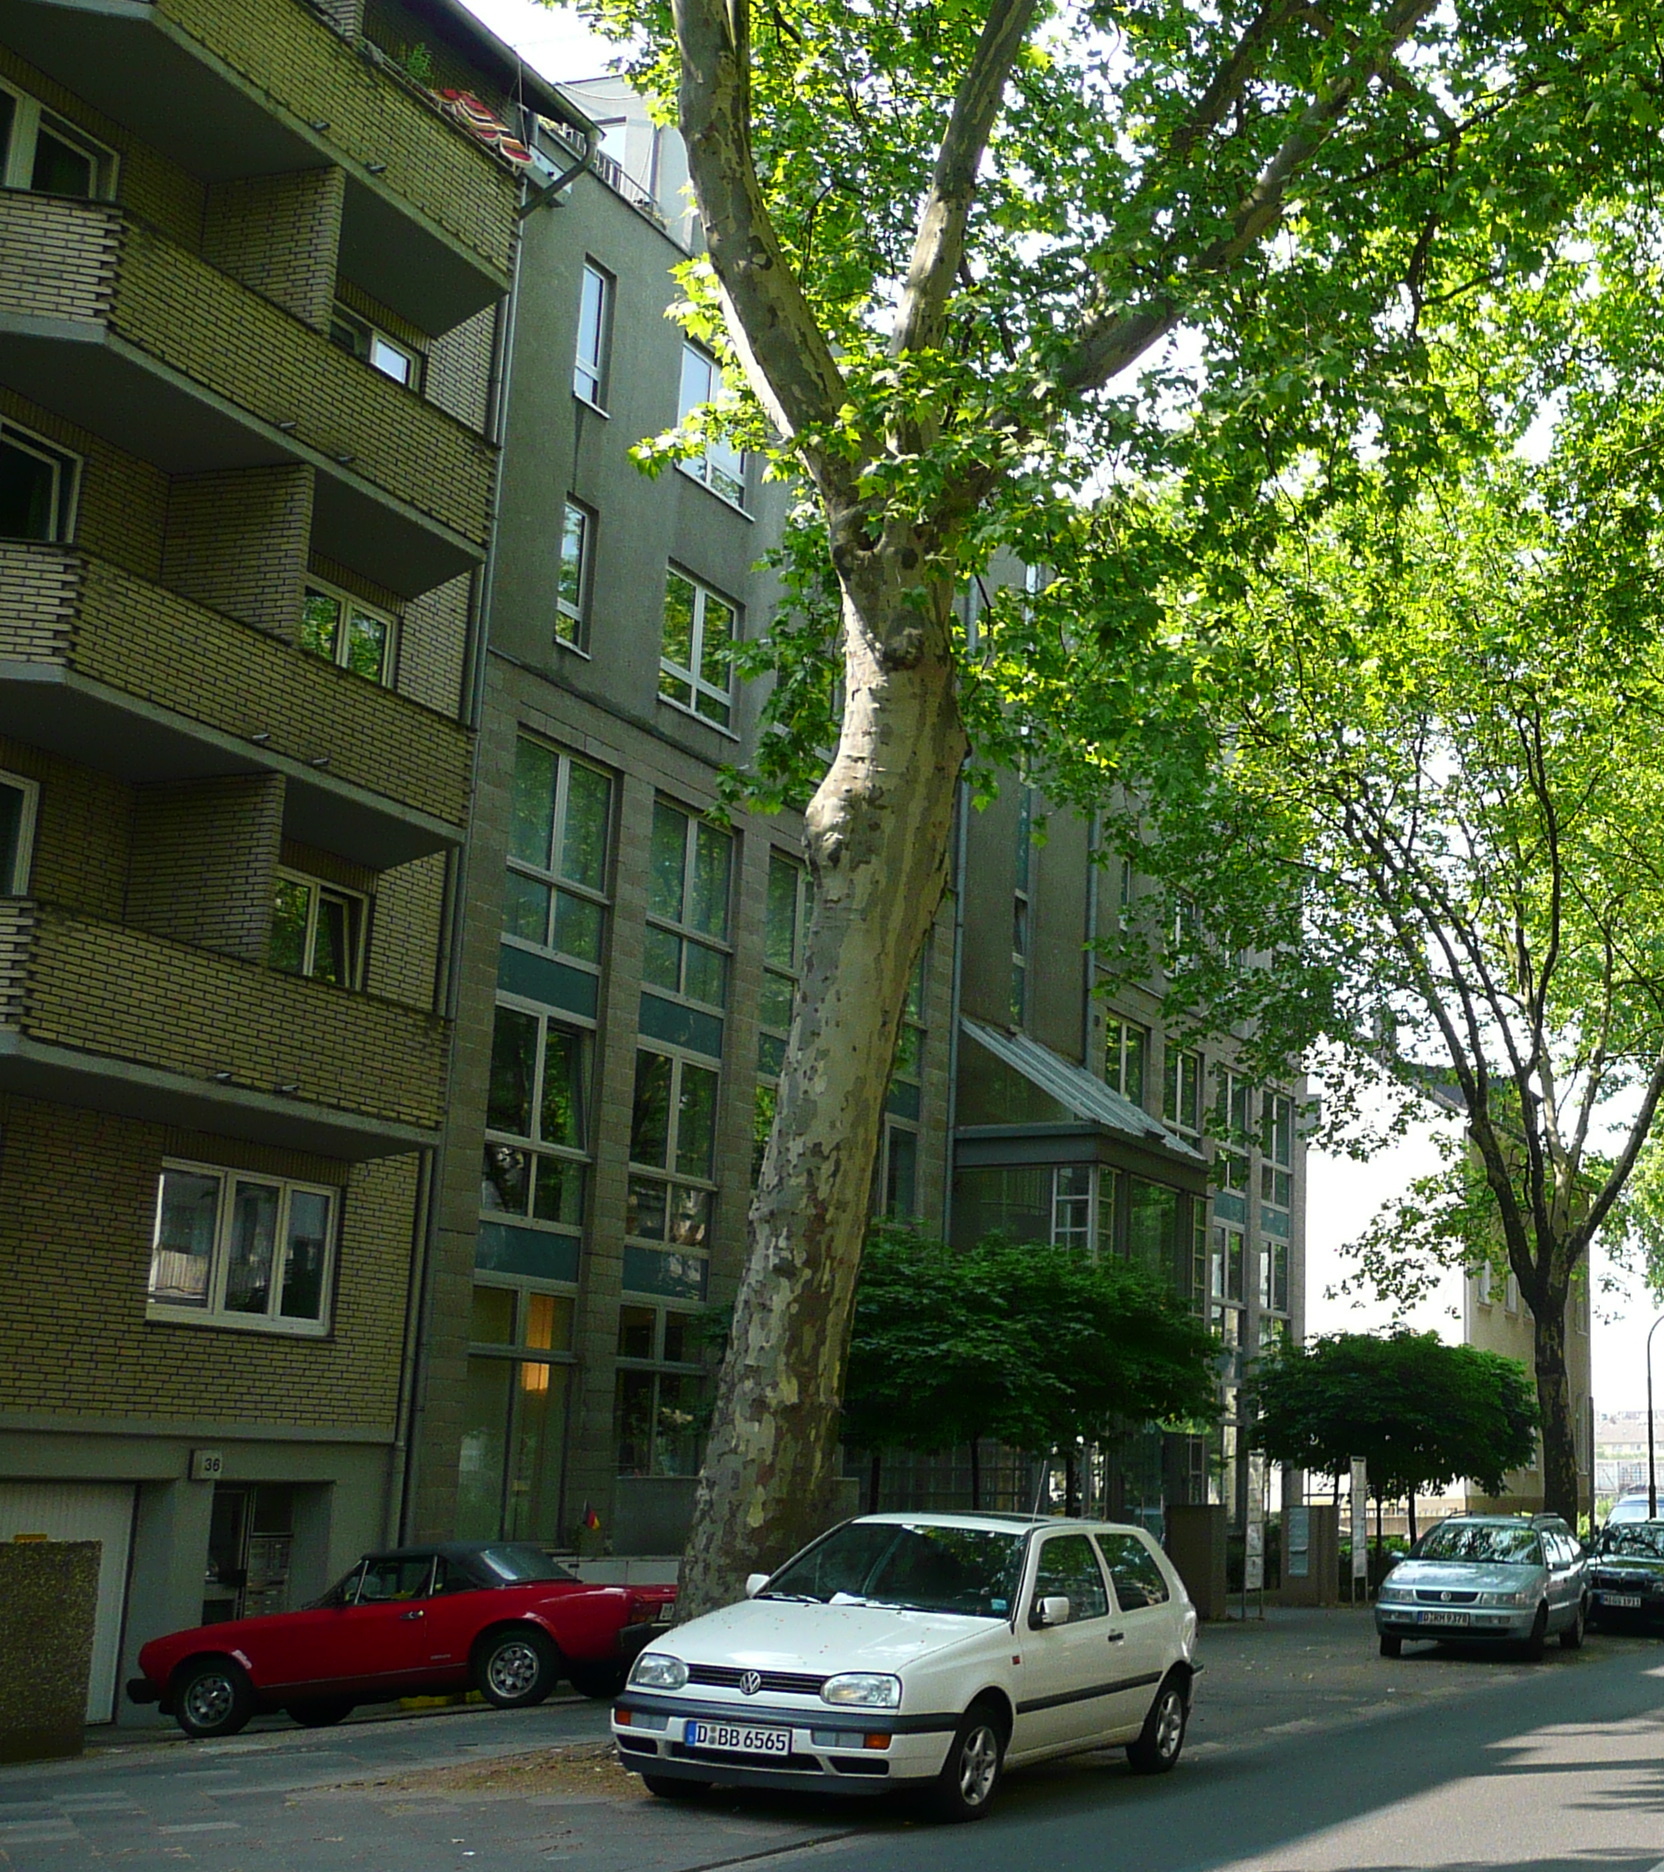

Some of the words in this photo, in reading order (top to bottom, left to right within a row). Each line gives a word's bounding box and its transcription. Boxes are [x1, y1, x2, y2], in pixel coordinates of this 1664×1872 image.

[205, 1457, 220, 1472] 36
[696, 1725, 708, 1743] D
[718, 1728, 740, 1747] BB
[743, 1730, 787, 1751] 6565
